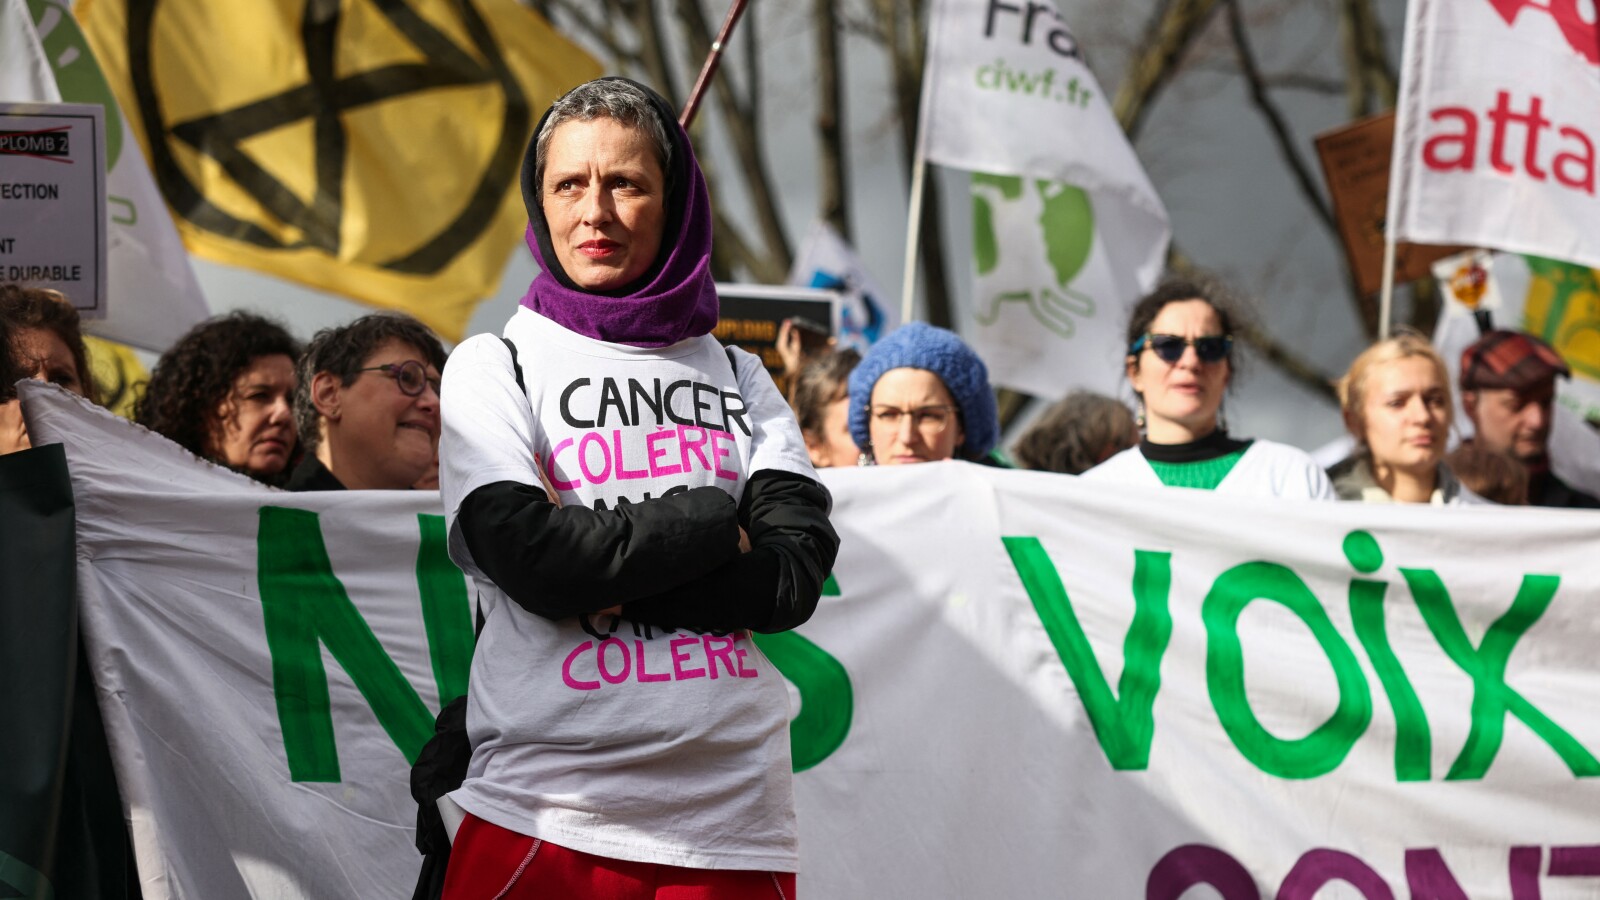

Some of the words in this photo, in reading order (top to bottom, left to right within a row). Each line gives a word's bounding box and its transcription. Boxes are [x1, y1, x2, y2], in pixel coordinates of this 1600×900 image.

[60, 137, 68, 151] 2
[1422, 89, 1596, 197] atta
[0, 183, 58, 199] ECTION
[9, 265, 81, 281] DURABLE
[559, 377, 751, 437] CANCER
[547, 424, 739, 491] COLÈRE
[562, 631, 758, 690] COLÈRE
